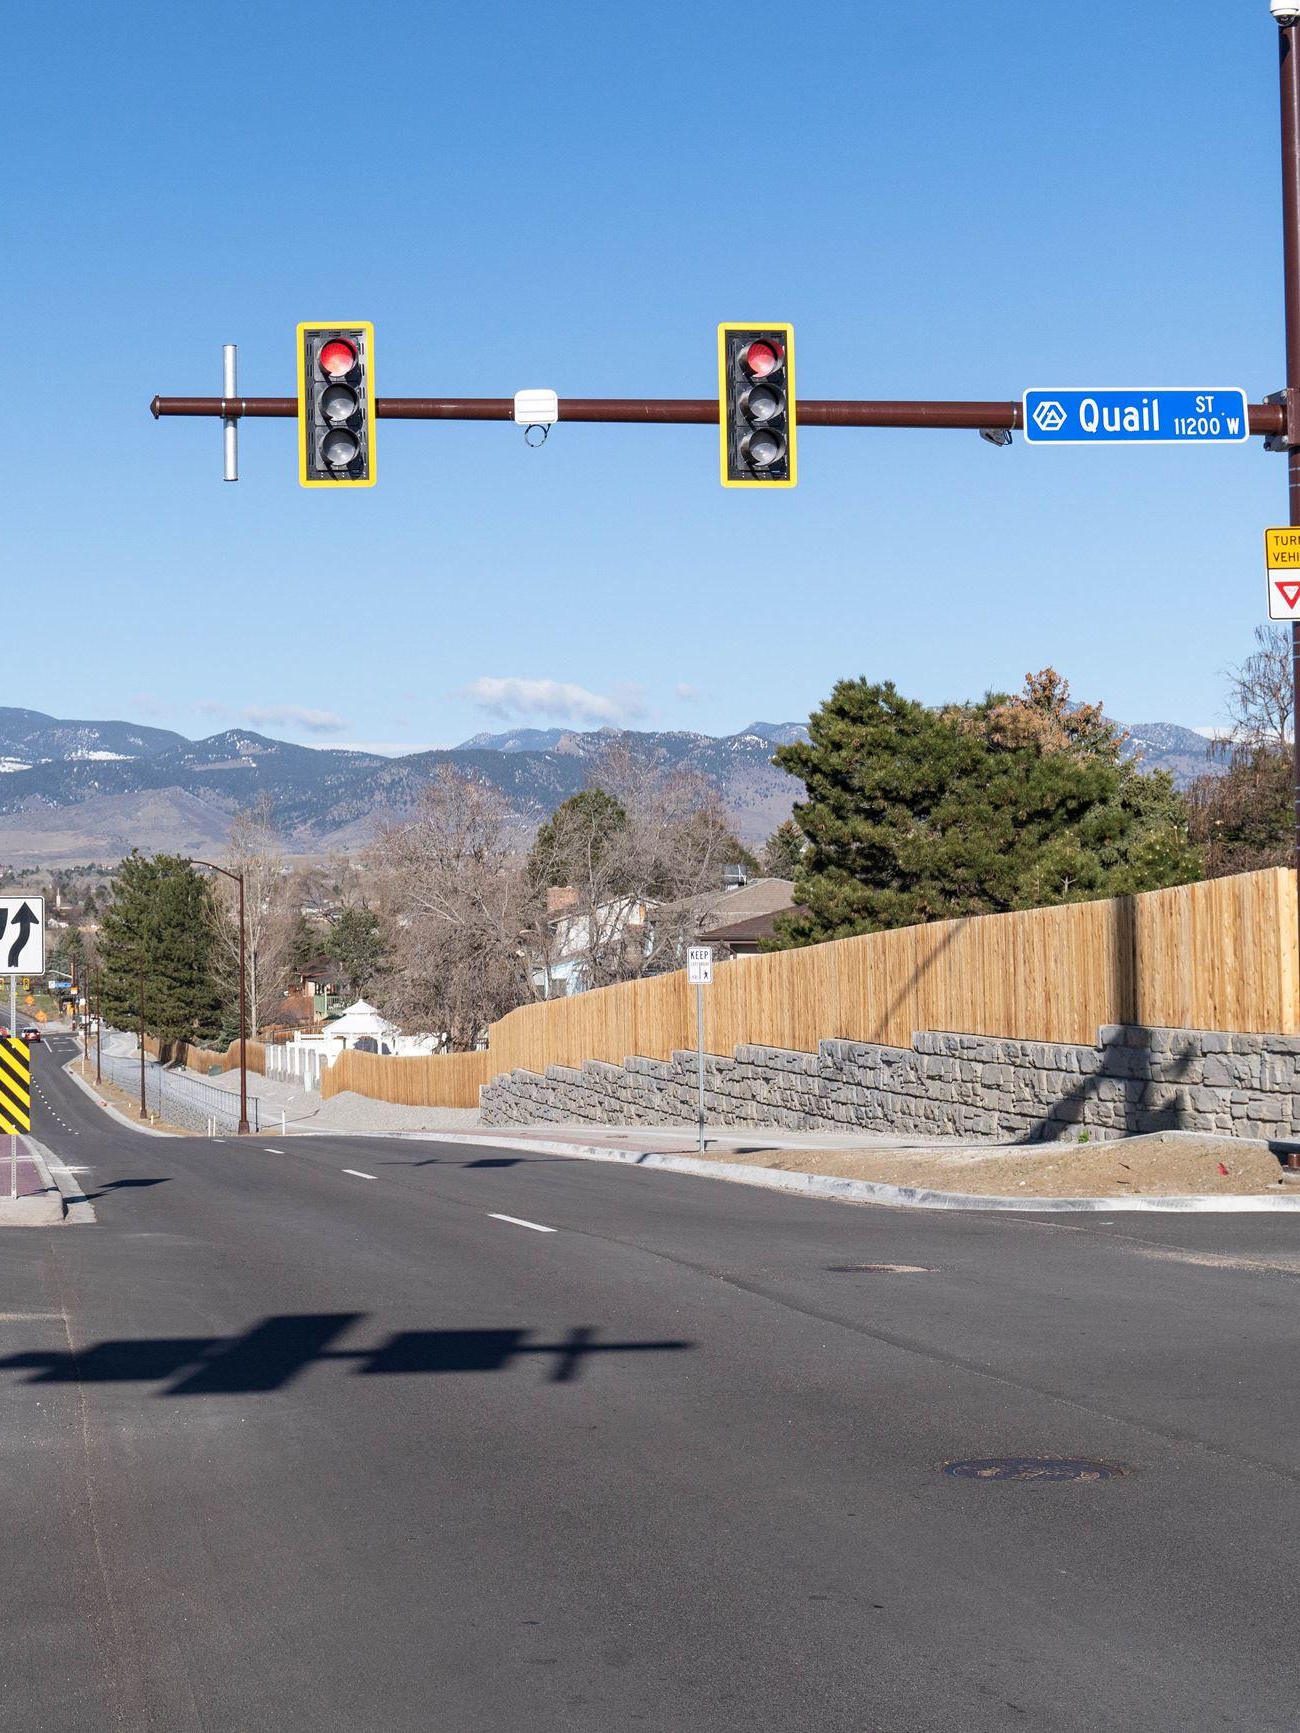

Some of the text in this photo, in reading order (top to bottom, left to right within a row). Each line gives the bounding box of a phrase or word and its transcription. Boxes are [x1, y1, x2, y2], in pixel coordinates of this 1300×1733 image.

[1079, 396, 1214, 433] Quail ST
[1174, 417, 1240, 435] 11200 W
[1273, 536, 1300, 545] TUR
[690, 951, 709, 959] KEEP
